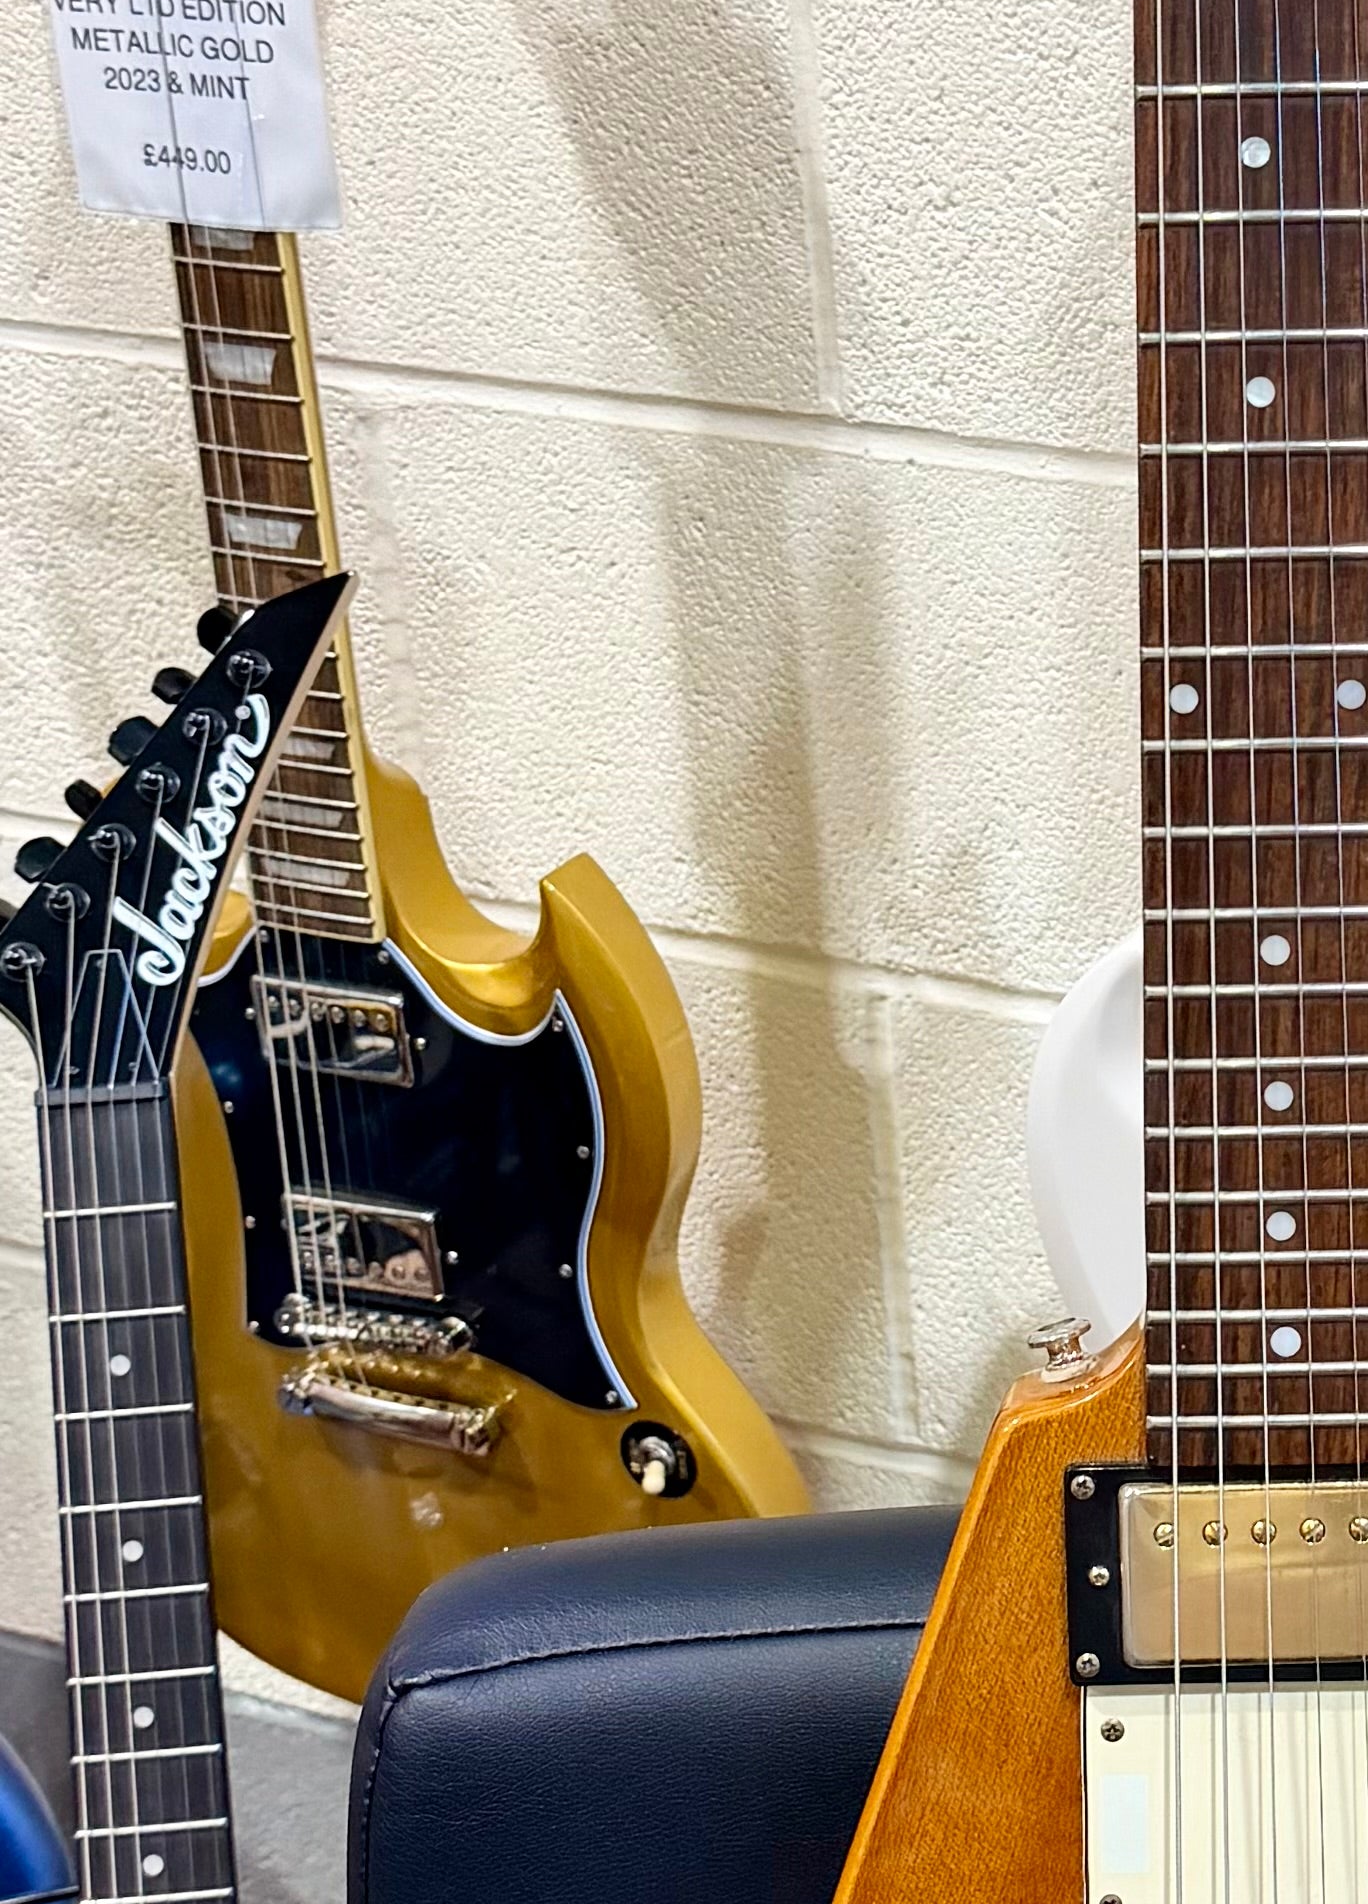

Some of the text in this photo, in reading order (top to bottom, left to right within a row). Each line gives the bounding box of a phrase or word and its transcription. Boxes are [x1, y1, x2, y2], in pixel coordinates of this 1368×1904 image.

[71, 27, 275, 64] METALLIC GOLD
[103, 66, 250, 101] 2023 & MINT
[143, 143, 232, 175] £449.00
[112, 693, 271, 986] Jackson
